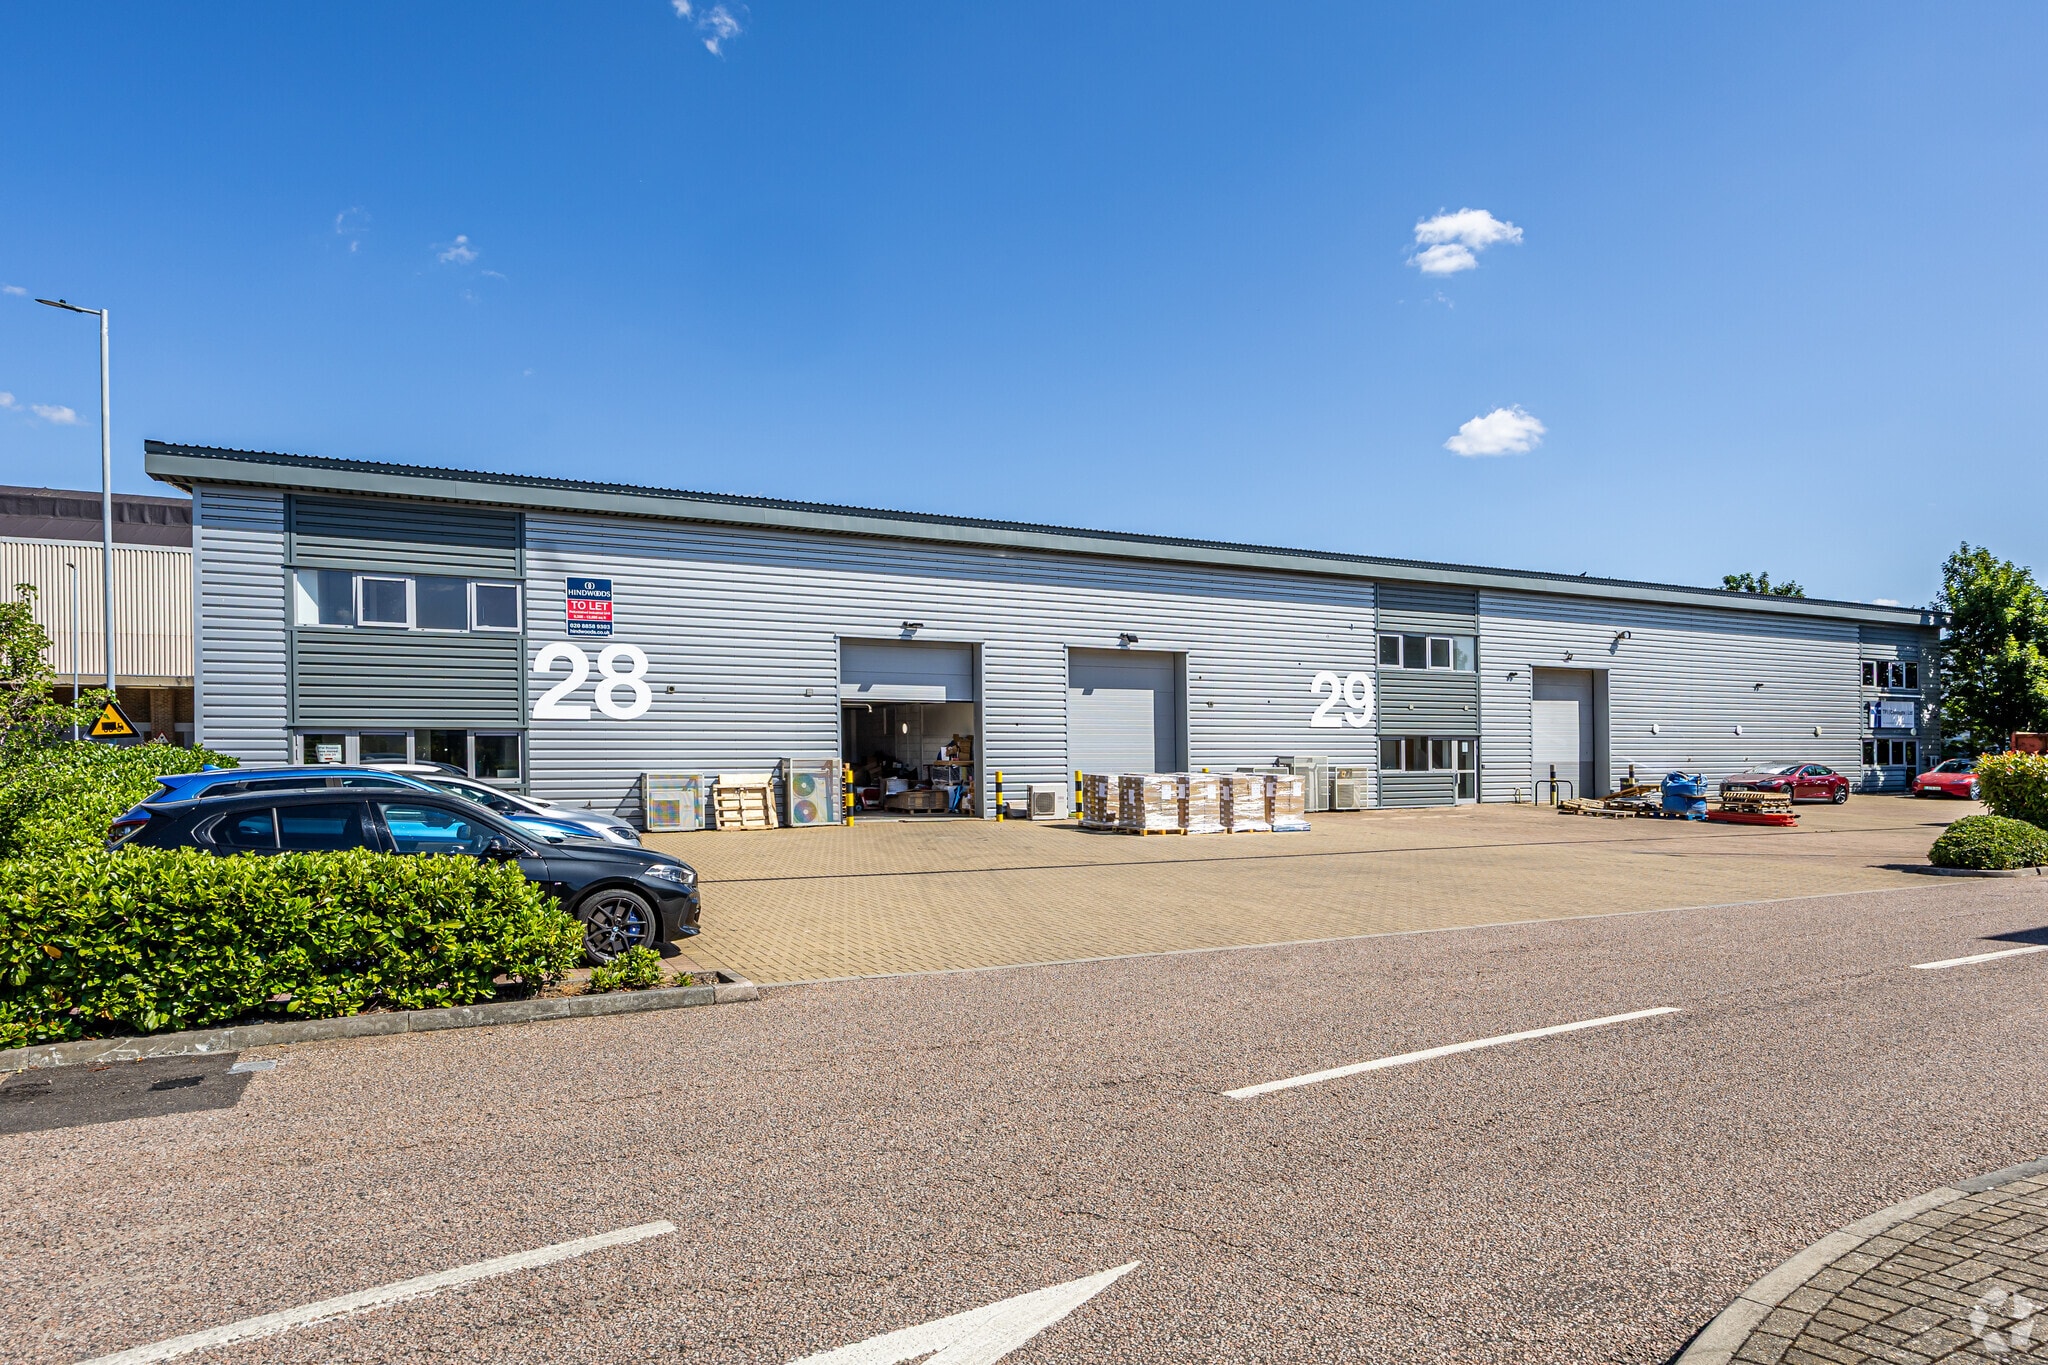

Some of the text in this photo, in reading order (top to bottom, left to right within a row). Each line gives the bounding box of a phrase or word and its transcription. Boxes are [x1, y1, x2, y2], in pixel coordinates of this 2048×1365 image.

[568, 589, 611, 597] HINDWOODS
[571, 600, 608, 610] TO LET
[532, 642, 652, 720] 28
[1310, 671, 1374, 728] 29
